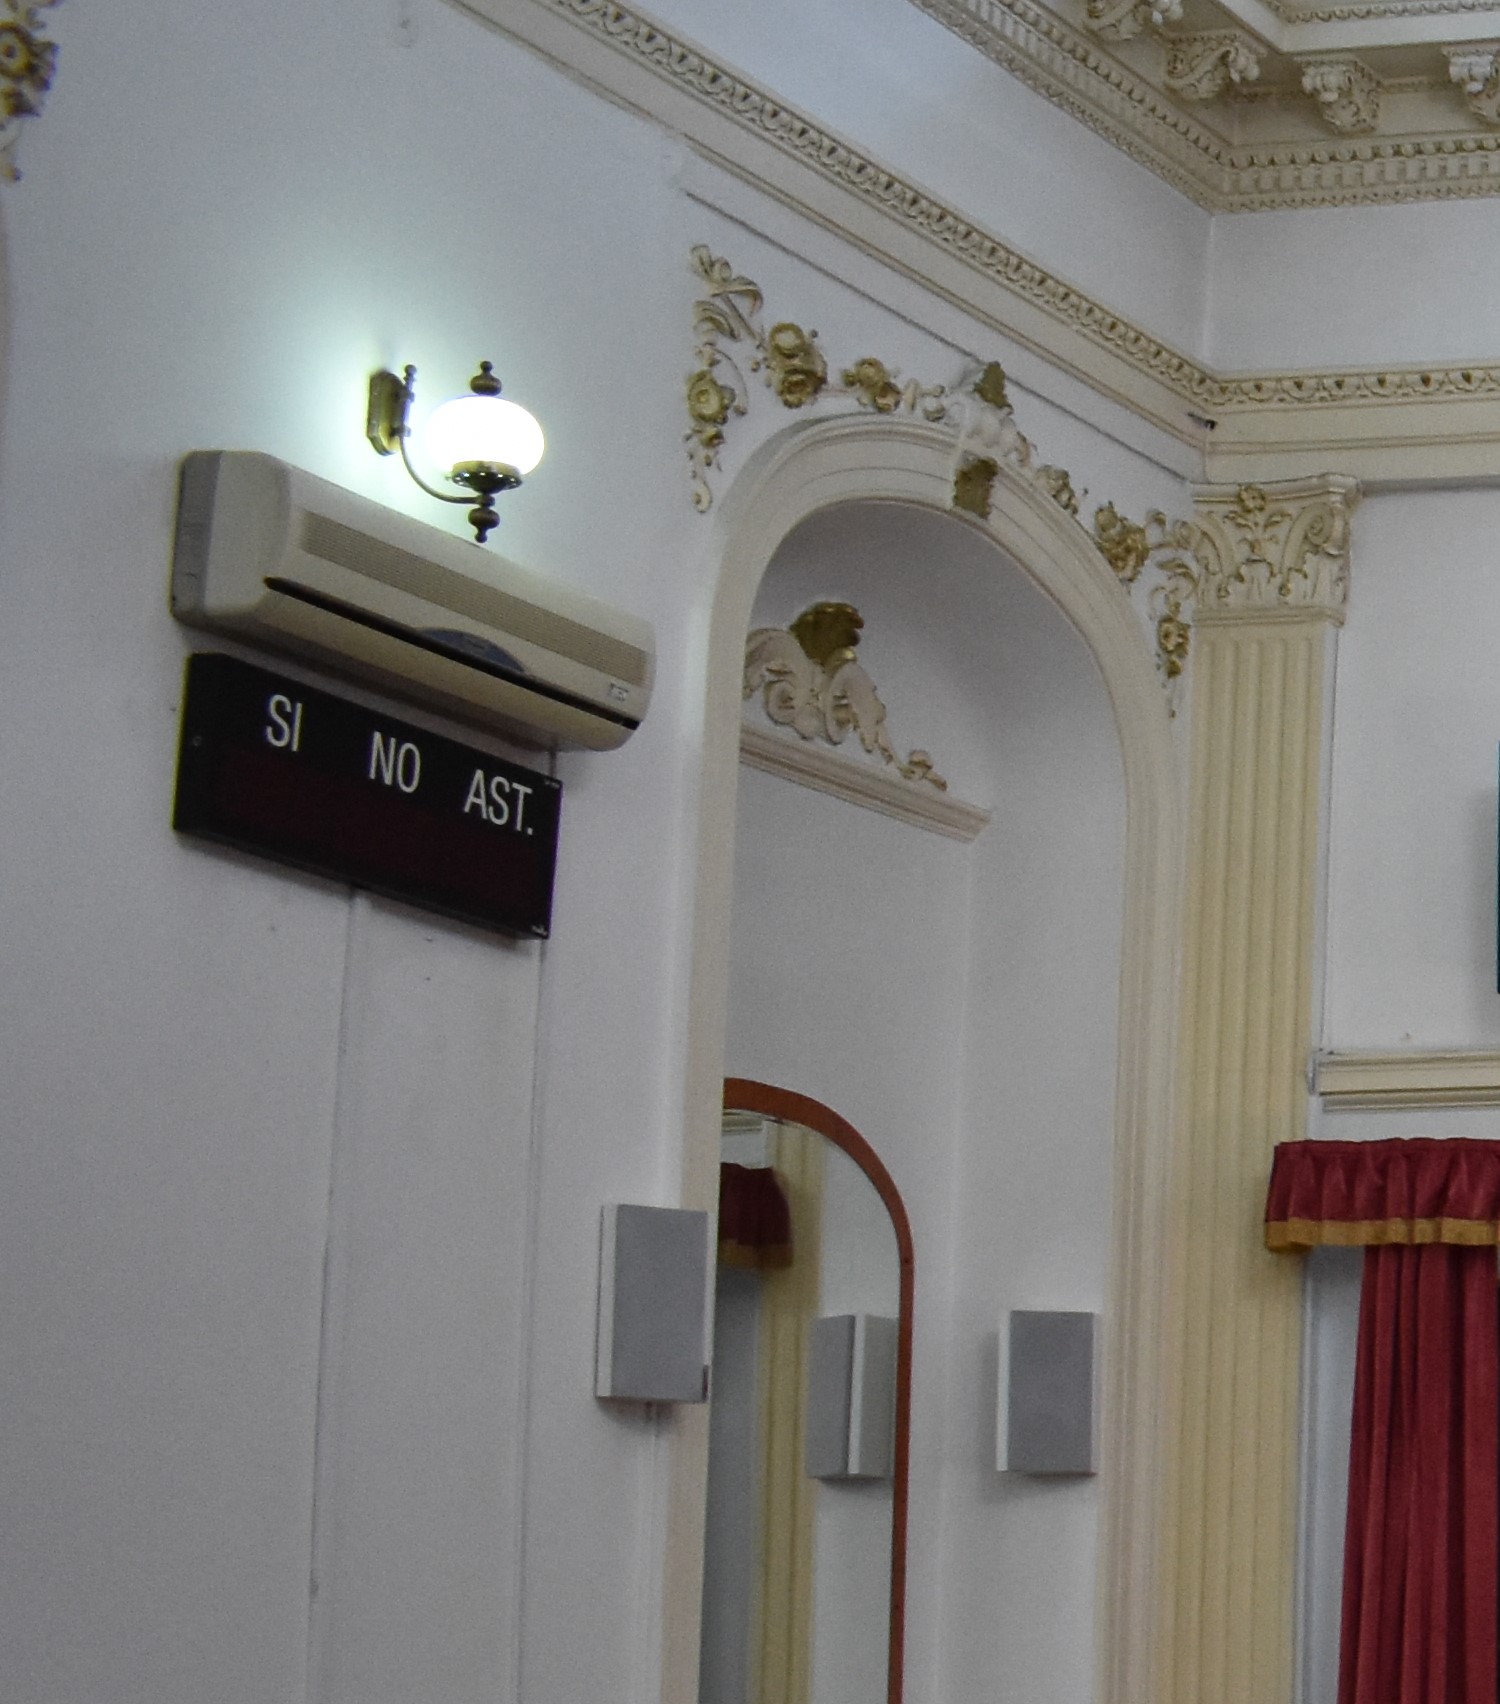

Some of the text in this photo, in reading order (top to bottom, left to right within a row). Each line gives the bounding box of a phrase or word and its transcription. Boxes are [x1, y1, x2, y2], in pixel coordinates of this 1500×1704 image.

[266, 694, 533, 836] SI NO AST.
